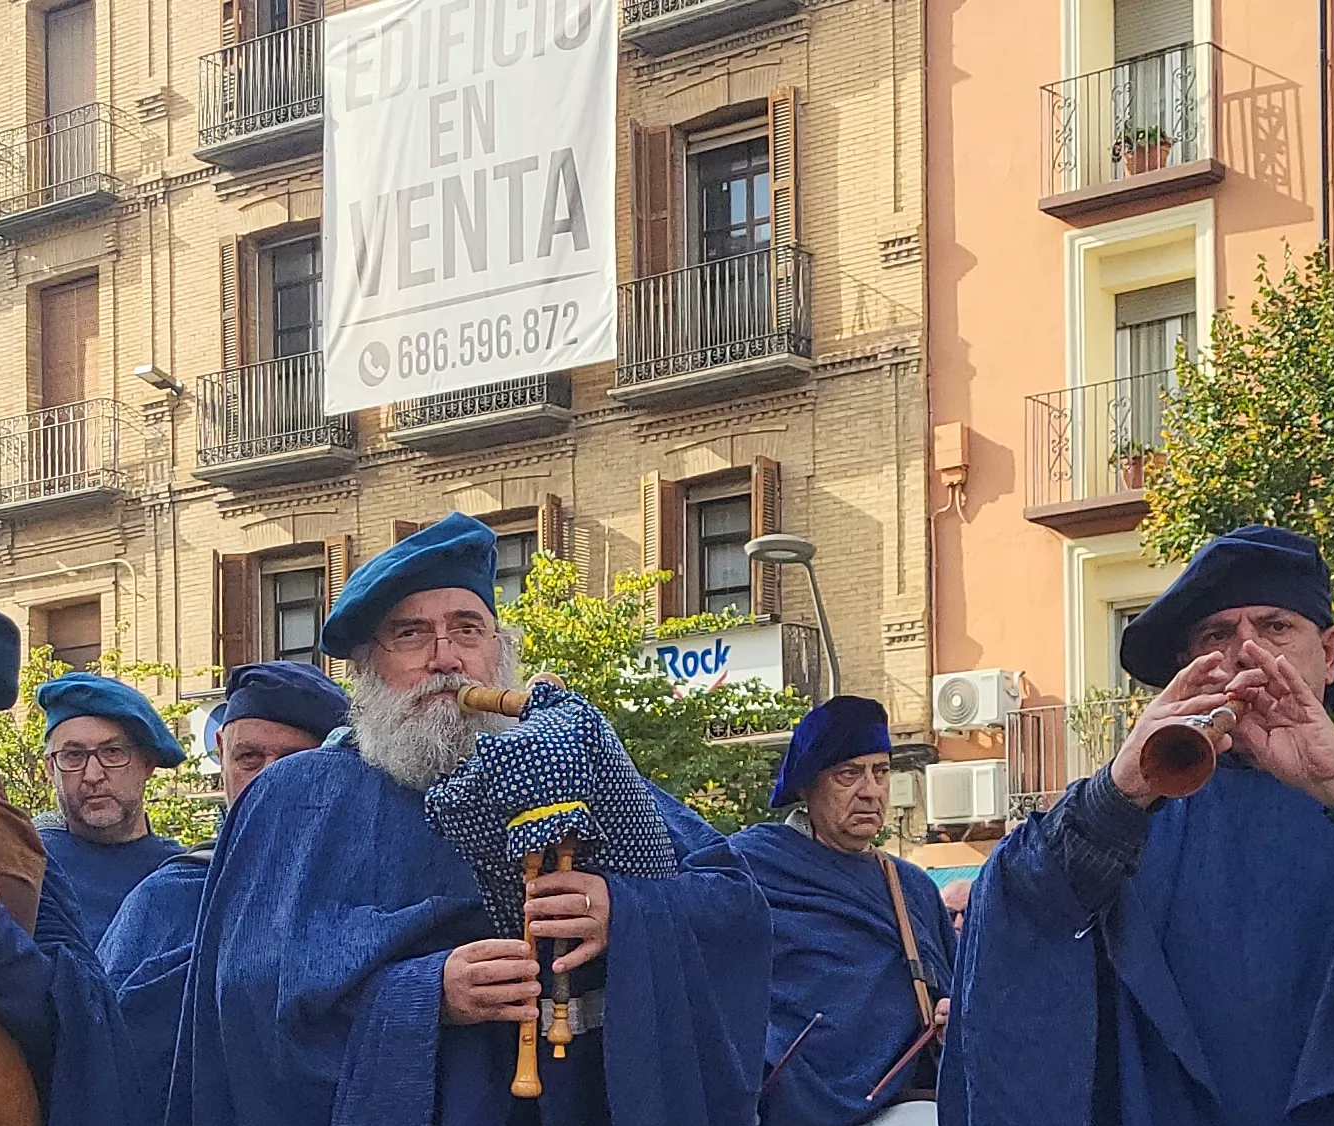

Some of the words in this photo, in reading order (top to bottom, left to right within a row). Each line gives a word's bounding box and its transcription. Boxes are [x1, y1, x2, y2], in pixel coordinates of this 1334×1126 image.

[346, 0, 592, 111] EDIFICIO
[429, 79, 496, 168] EN
[349, 146, 591, 299] VENTA
[398, 301, 580, 379] 686.596.872
[656, 638, 732, 679] Rock
